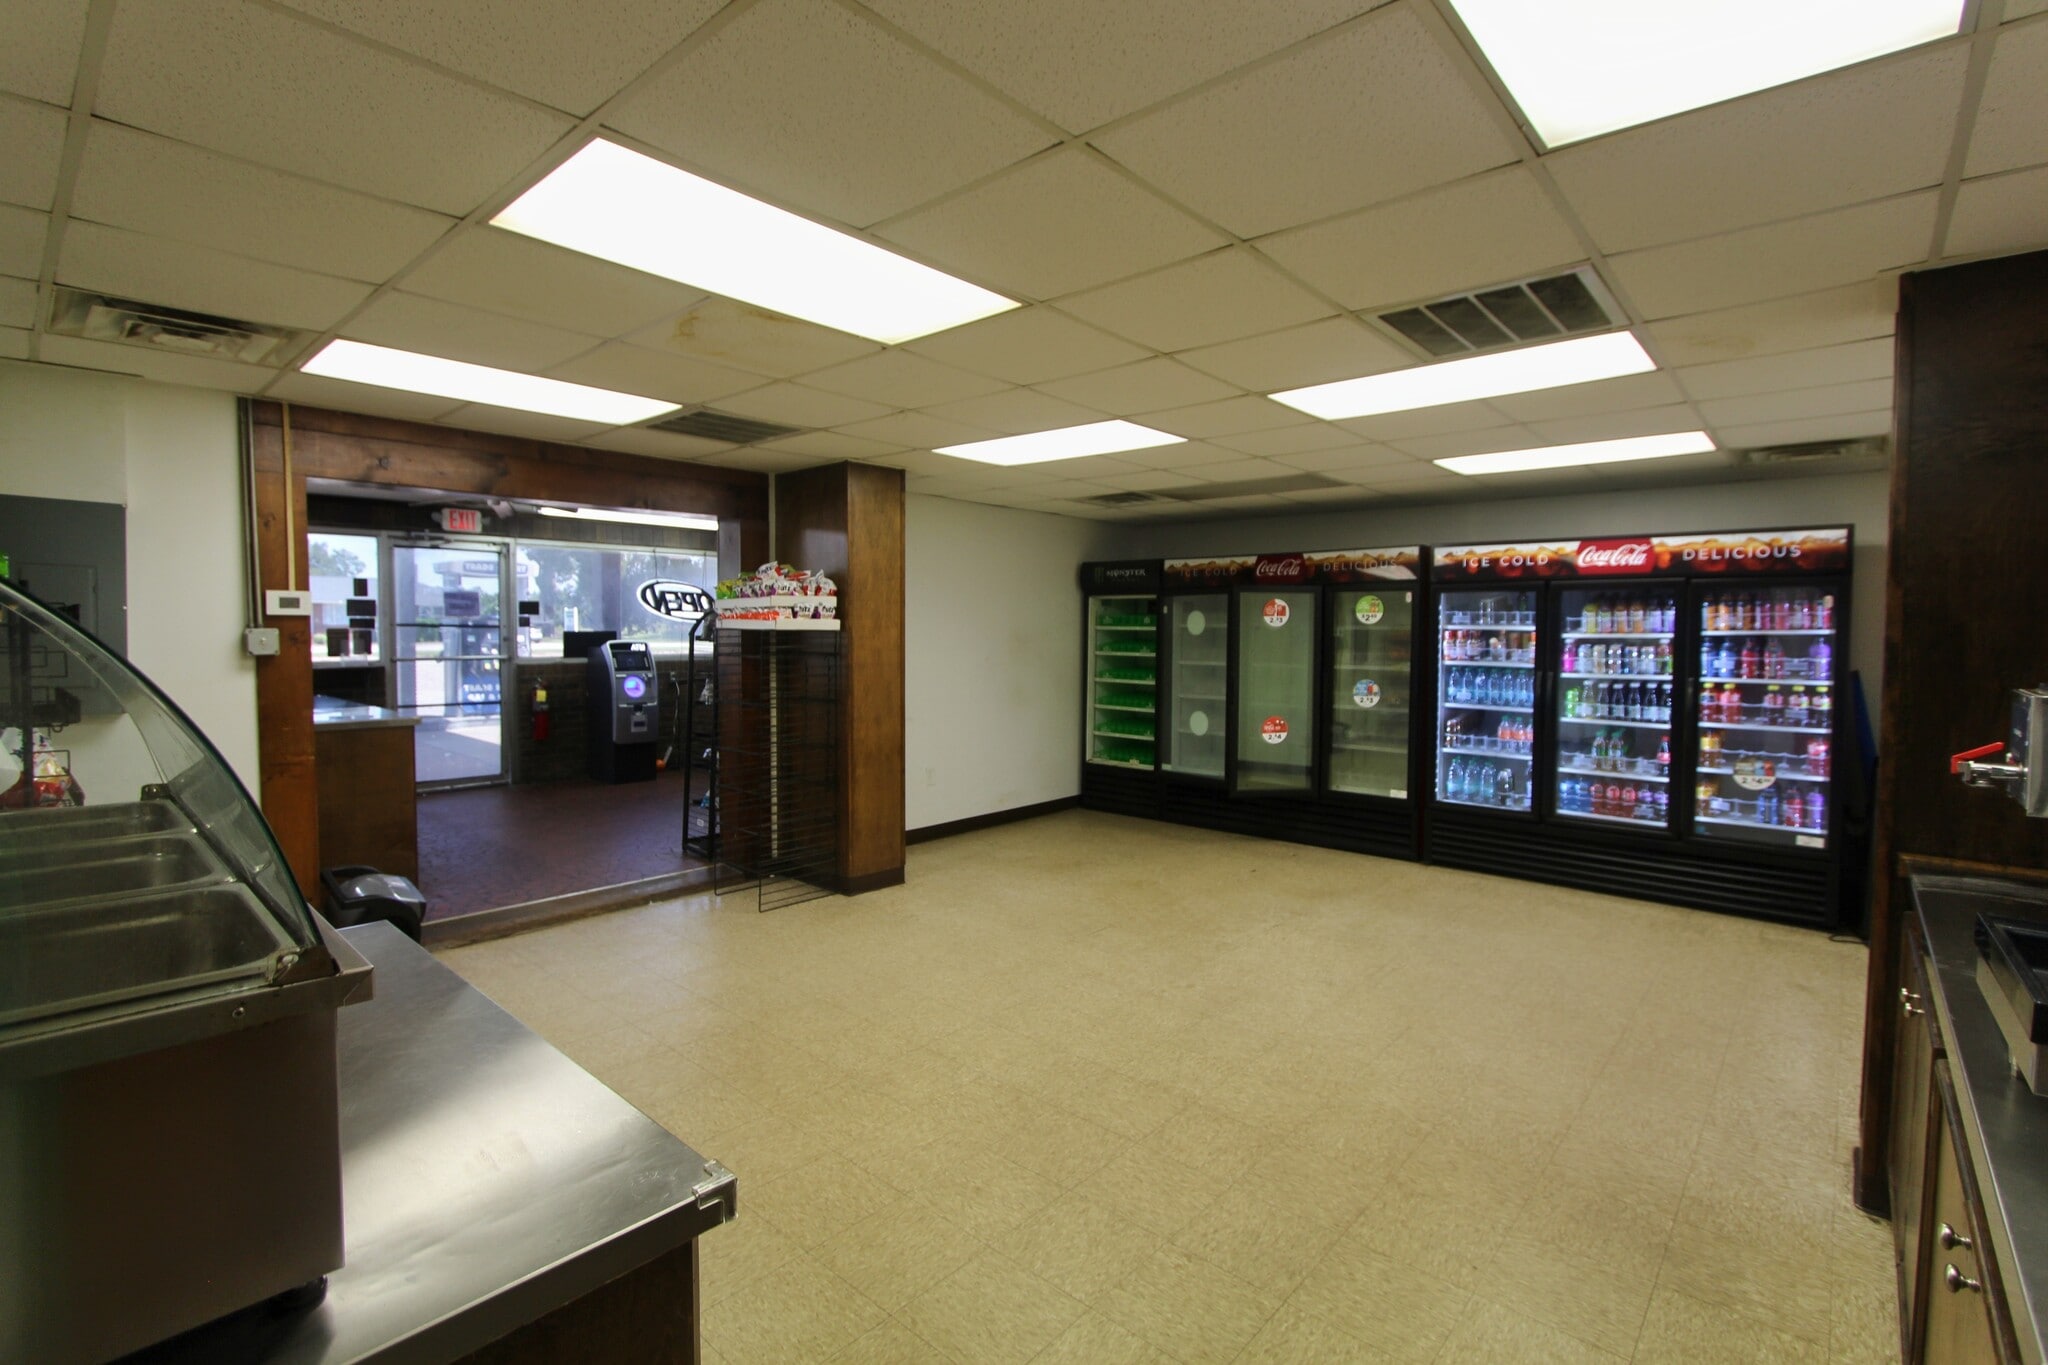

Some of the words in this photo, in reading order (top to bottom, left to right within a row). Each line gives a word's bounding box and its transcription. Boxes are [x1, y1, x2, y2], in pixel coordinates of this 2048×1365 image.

[449, 509, 476, 531] EXIT
[1462, 556, 1491, 568] ICE
[1499, 554, 1549, 567] COLD
[1682, 544, 1802, 561] DELICIOUS
[1180, 567, 1198, 577] ICE
[1206, 566, 1237, 577] COLD
[1323, 559, 1397, 572] DELICIOUS
